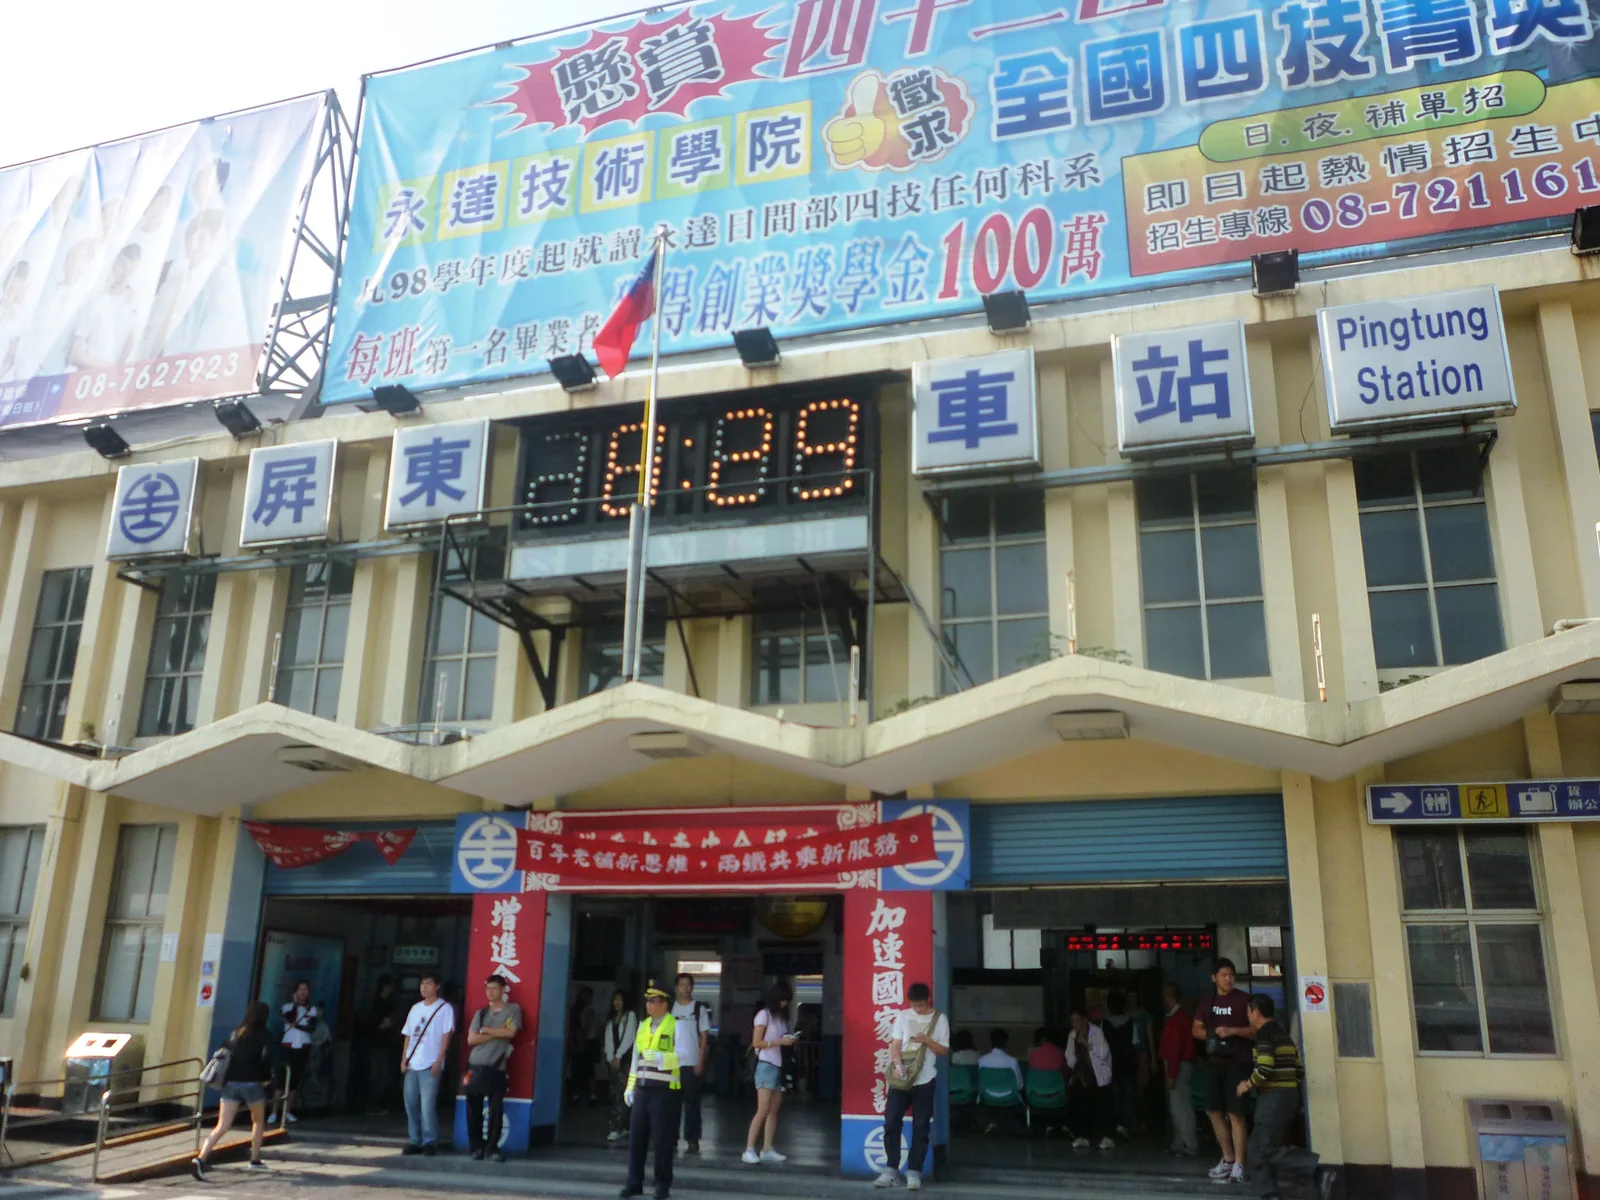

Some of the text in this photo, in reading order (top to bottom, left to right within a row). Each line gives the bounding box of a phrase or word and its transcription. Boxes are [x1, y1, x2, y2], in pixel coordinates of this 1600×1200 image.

[557, 20, 723, 122] 懸賞
[890, 69, 955, 157] 徵求
[384, 115, 802, 240] 永達技術學院
[1149, 207, 1290, 252] 招生專線
[1336, 304, 1489, 351] Pingtung
[75, 352, 238, 400] 08-7627923
[1358, 359, 1483, 404] Station
